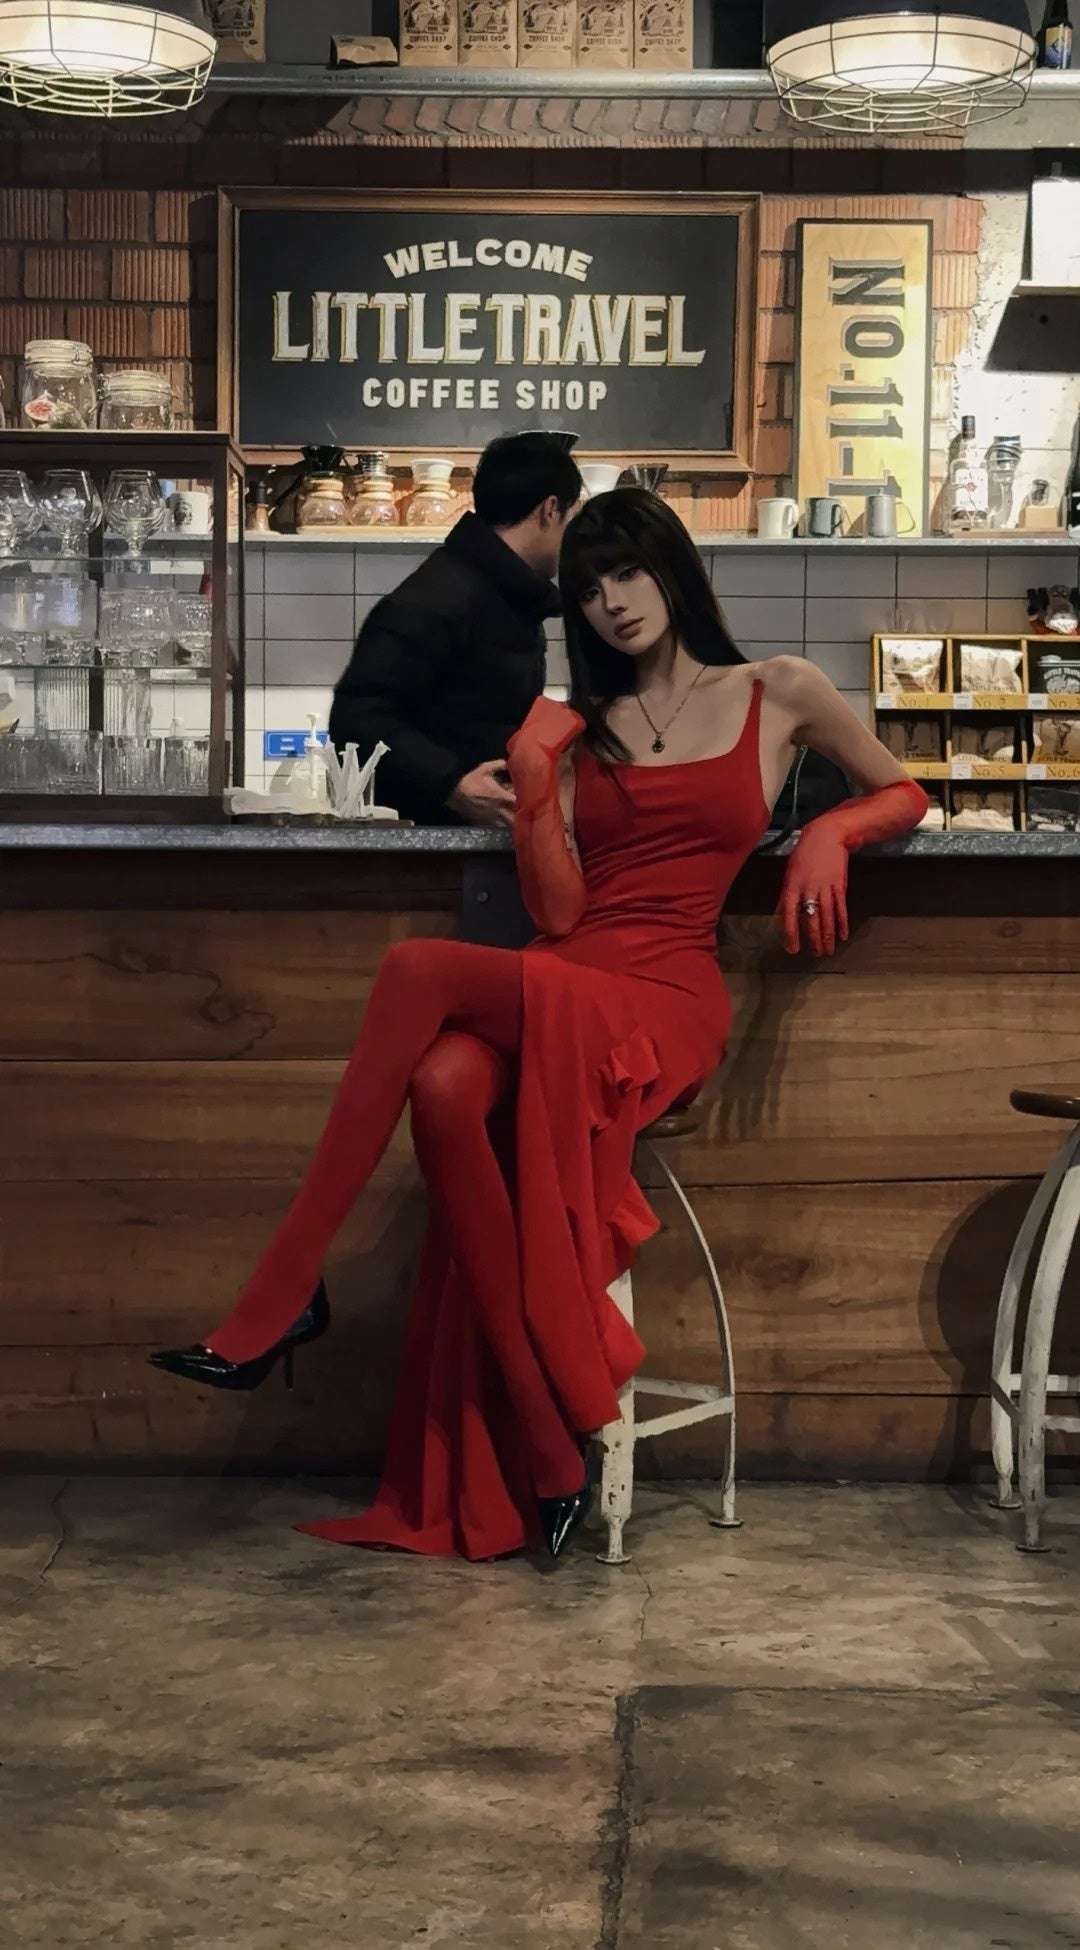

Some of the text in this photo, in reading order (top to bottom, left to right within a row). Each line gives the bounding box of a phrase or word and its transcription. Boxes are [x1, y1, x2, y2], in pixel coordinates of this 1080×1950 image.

[383, 238, 594, 282] WELCOME
[362, 377, 607, 411] COFFEE SHOP
